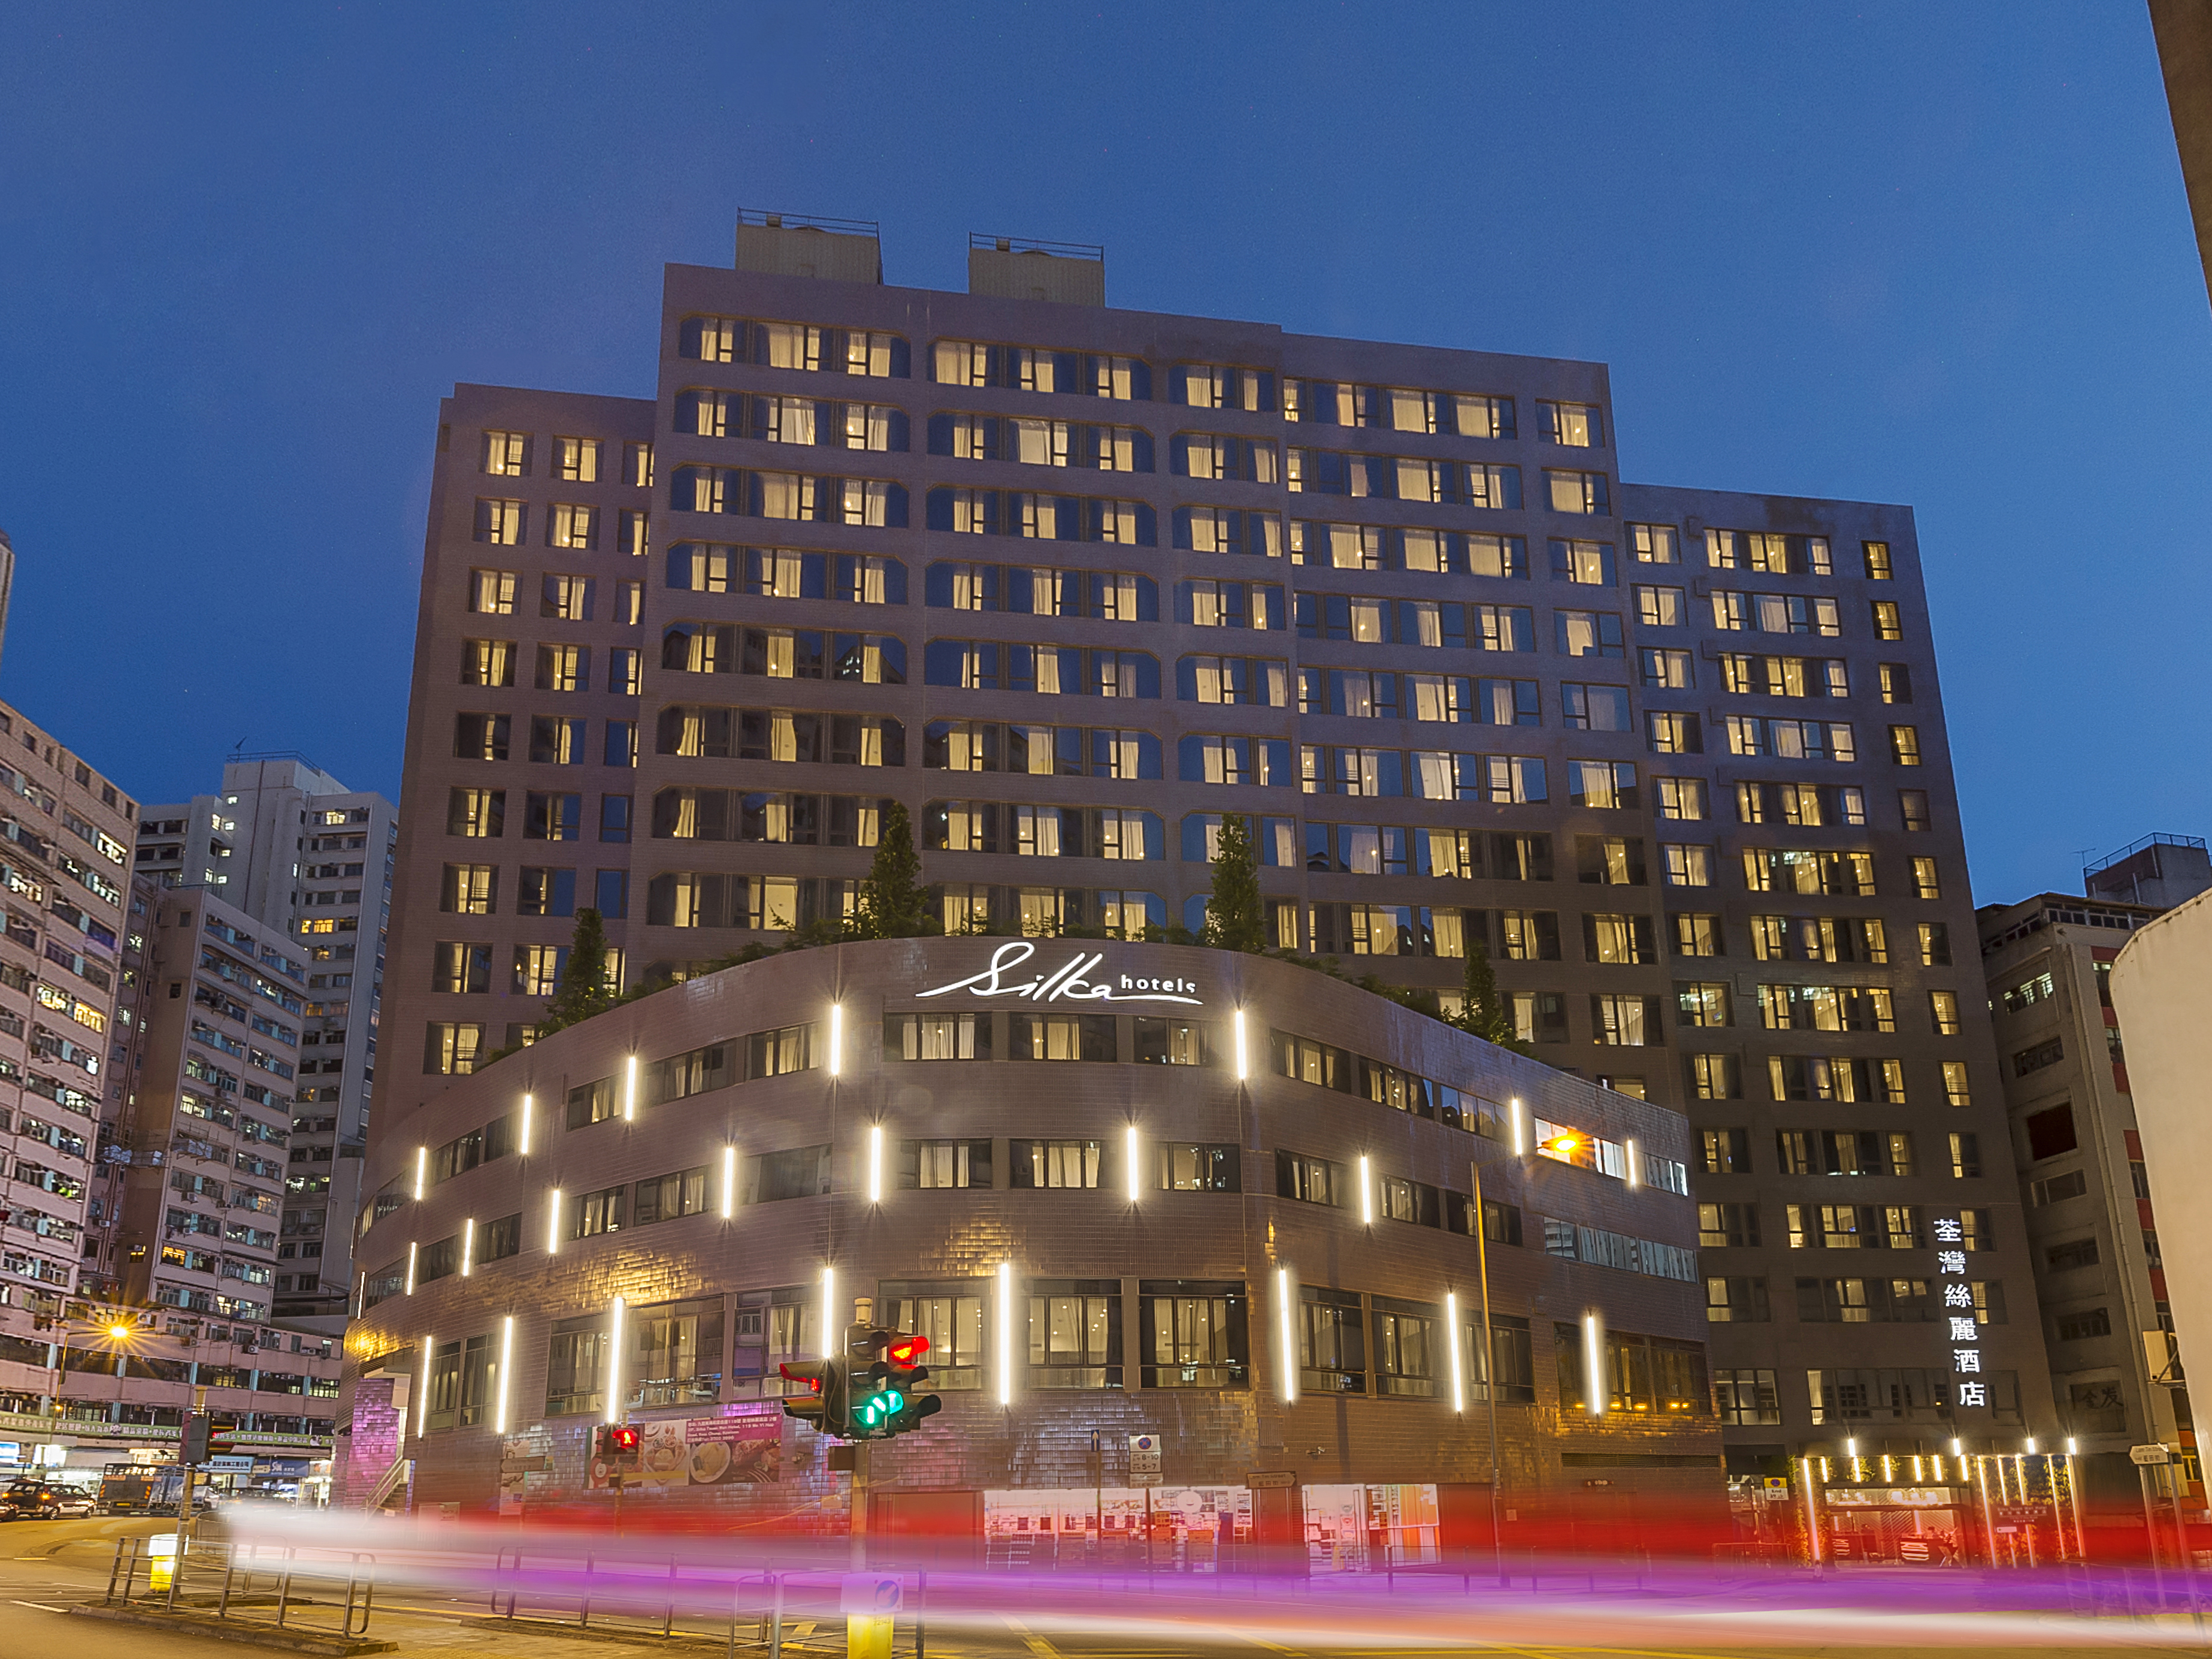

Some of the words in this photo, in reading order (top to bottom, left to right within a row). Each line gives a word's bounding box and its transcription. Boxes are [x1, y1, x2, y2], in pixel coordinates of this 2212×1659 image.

[915, 941, 1203, 1005] Silka
[1121, 975, 1196, 993] hotels
[1933, 1219, 1985, 1407] 荃灣絲麗酒店
